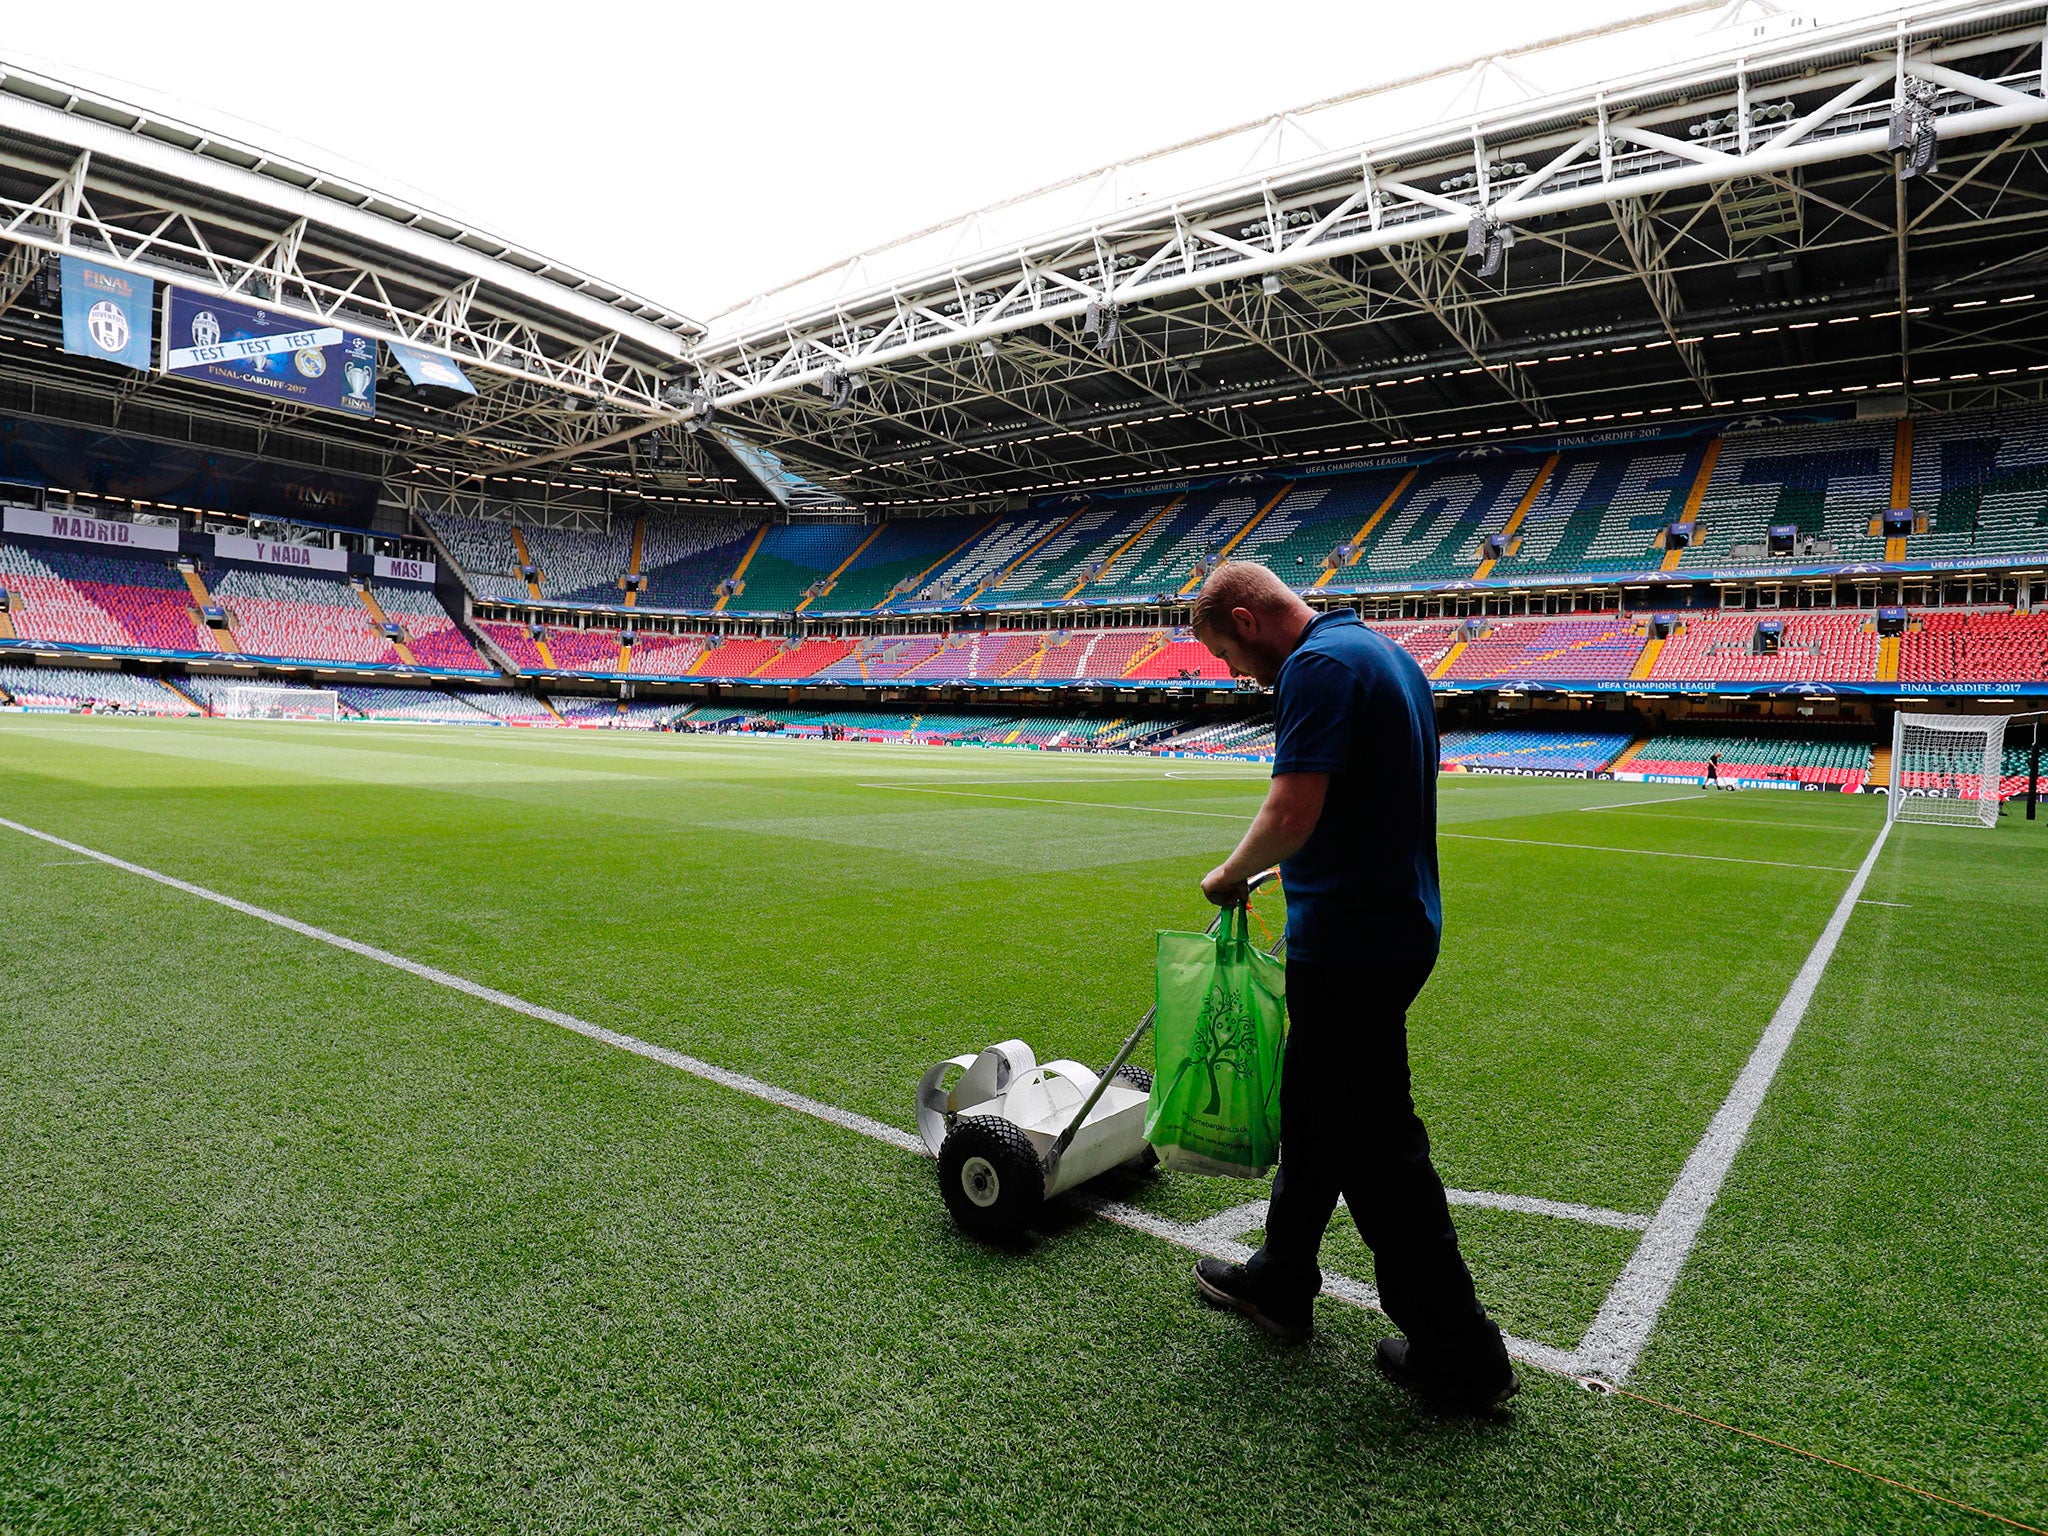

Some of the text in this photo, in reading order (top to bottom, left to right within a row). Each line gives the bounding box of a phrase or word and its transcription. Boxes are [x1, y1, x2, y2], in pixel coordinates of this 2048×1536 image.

[84, 269, 133, 291] FINAL
[189, 333, 317, 362] TEST TEST TEST
[209, 365, 307, 395] FINAL CARDIFF 2017
[342, 396, 374, 410] FINAL
[1305, 456, 1408, 474] UEFA CHAMPIONS LEAGUE
[52, 515, 136, 545] MADRID.
[256, 543, 311, 566] Y NADA
[1930, 555, 2048, 569] UEFA CHAMPIONS LEAGUE
[390, 560, 423, 580] MAS!
[298, 658, 333, 667] CHAMPIONS
[1623, 682, 1677, 690] CHAMPIONS
[1680, 682, 1716, 690] LEAGUE
[1900, 684, 1935, 692] FINAL
[1995, 684, 2021, 692] 2017
[883, 737, 929, 746] NISSAN
[1184, 752, 1247, 762] PlayStation
[1472, 766, 1588, 780] mastercard
